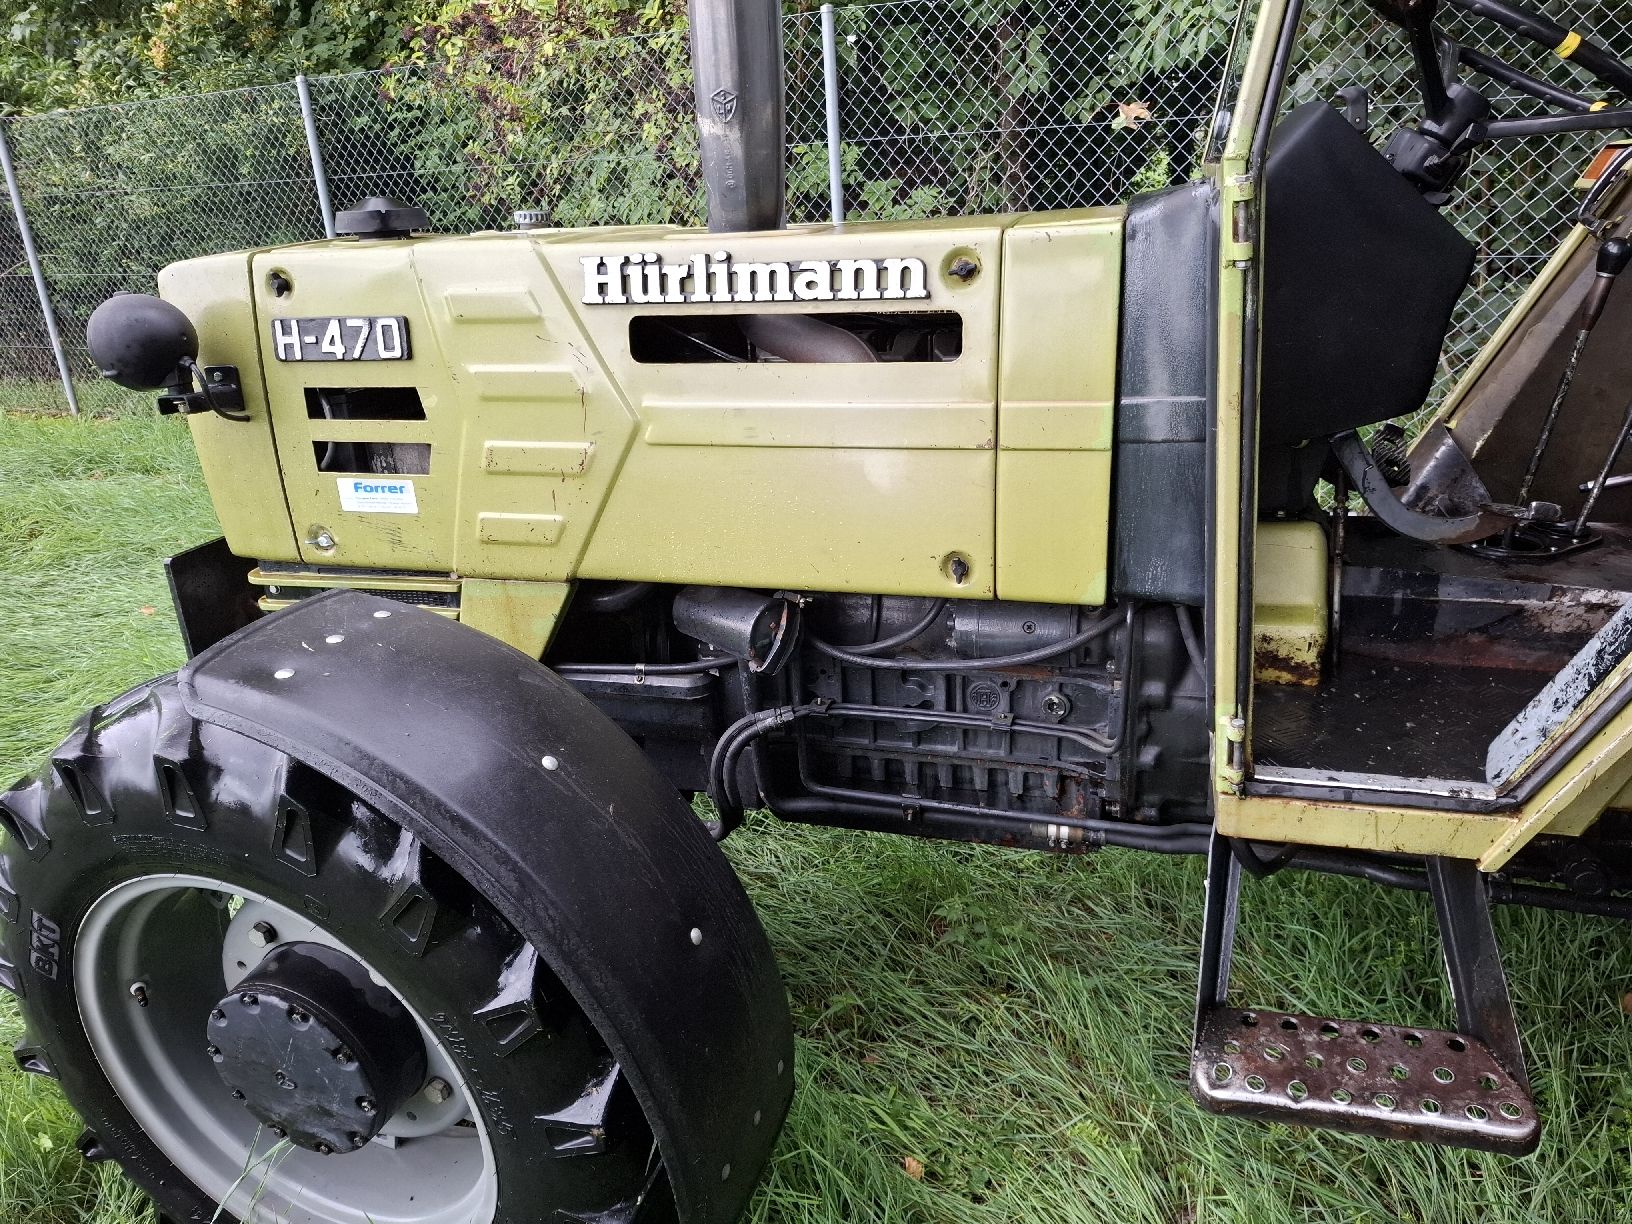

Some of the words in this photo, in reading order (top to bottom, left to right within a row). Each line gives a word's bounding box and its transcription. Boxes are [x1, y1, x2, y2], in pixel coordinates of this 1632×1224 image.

[580, 251, 929, 305] Hürlimann
[273, 318, 404, 360] H-470
[353, 481, 407, 495] Forrer
[30, 909, 62, 979] BKT
